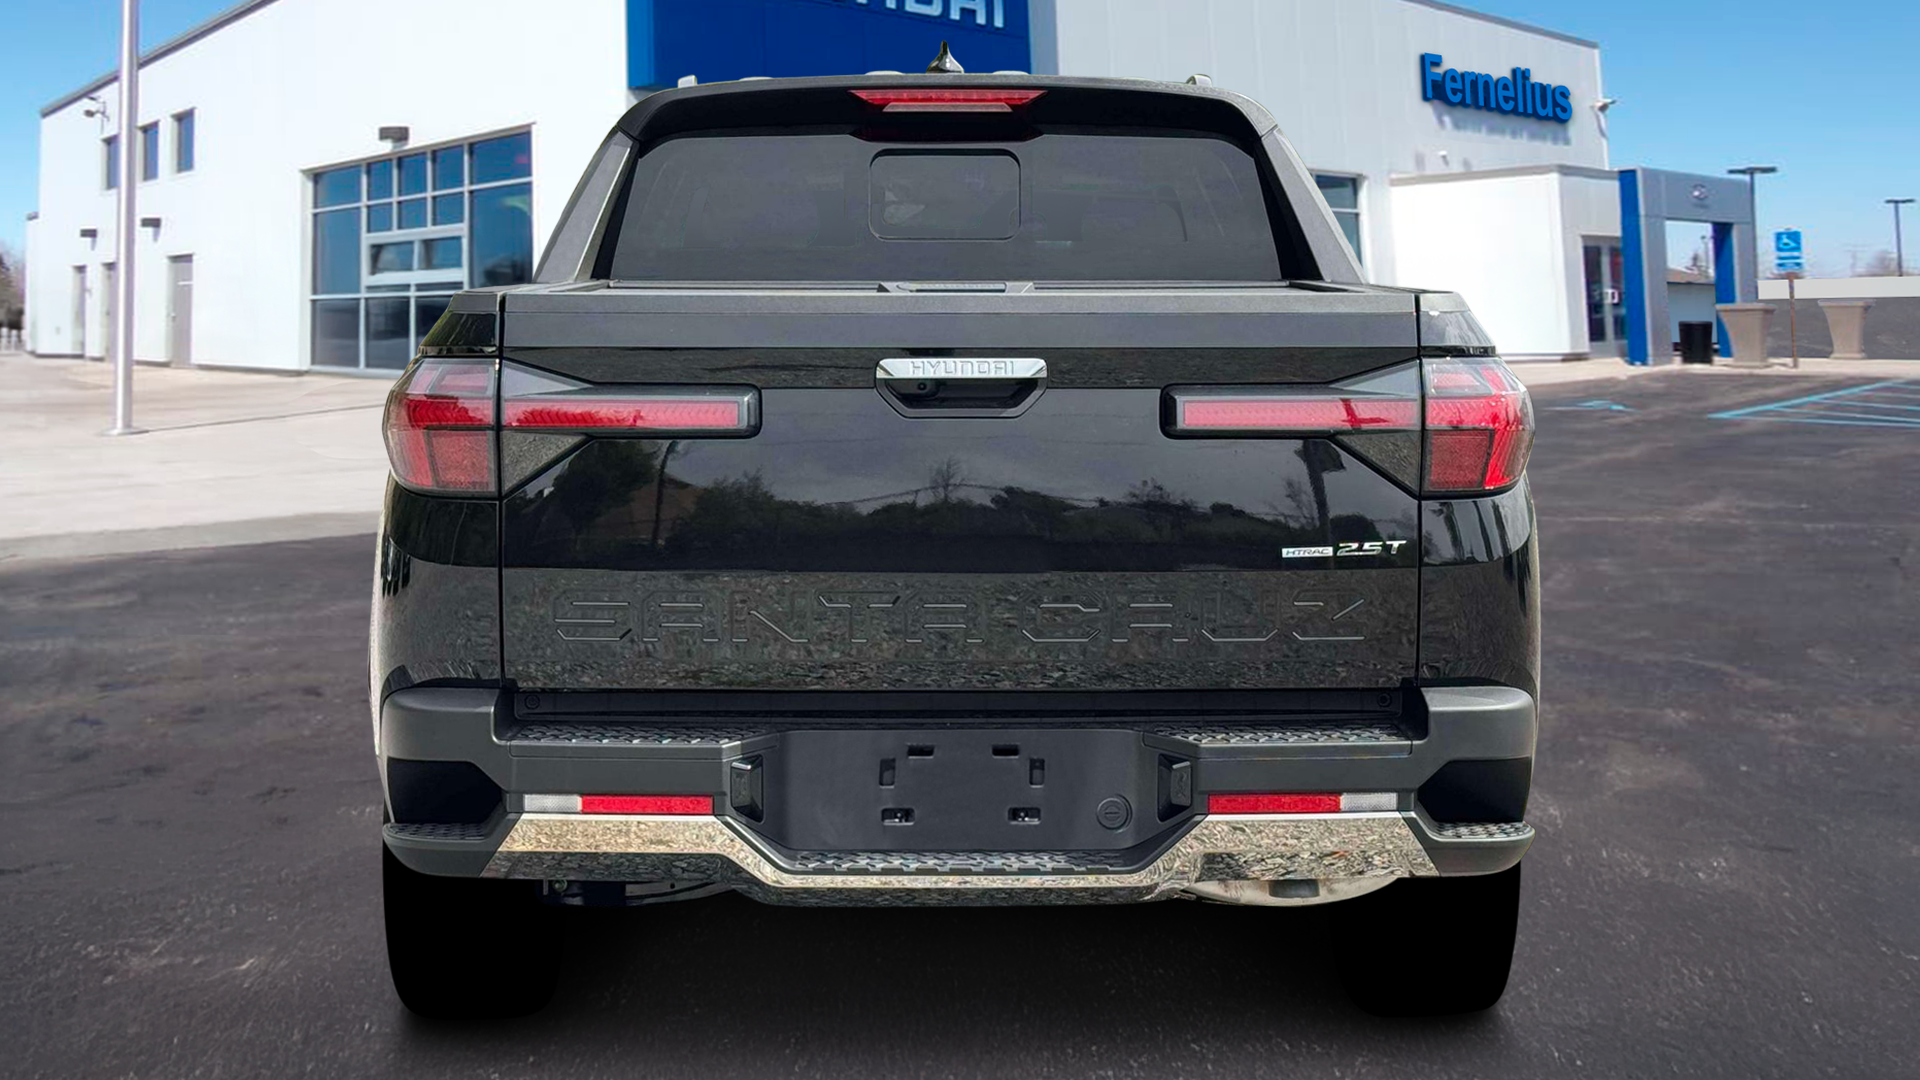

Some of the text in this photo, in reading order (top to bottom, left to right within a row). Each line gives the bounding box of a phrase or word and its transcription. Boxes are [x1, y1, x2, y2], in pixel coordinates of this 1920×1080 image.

[1421, 52, 1573, 123] Fernelius
[911, 361, 1015, 375] HYUNDAI
[1285, 547, 1331, 556] HTRAC
[554, 588, 1366, 643] SANTA CRUZ
